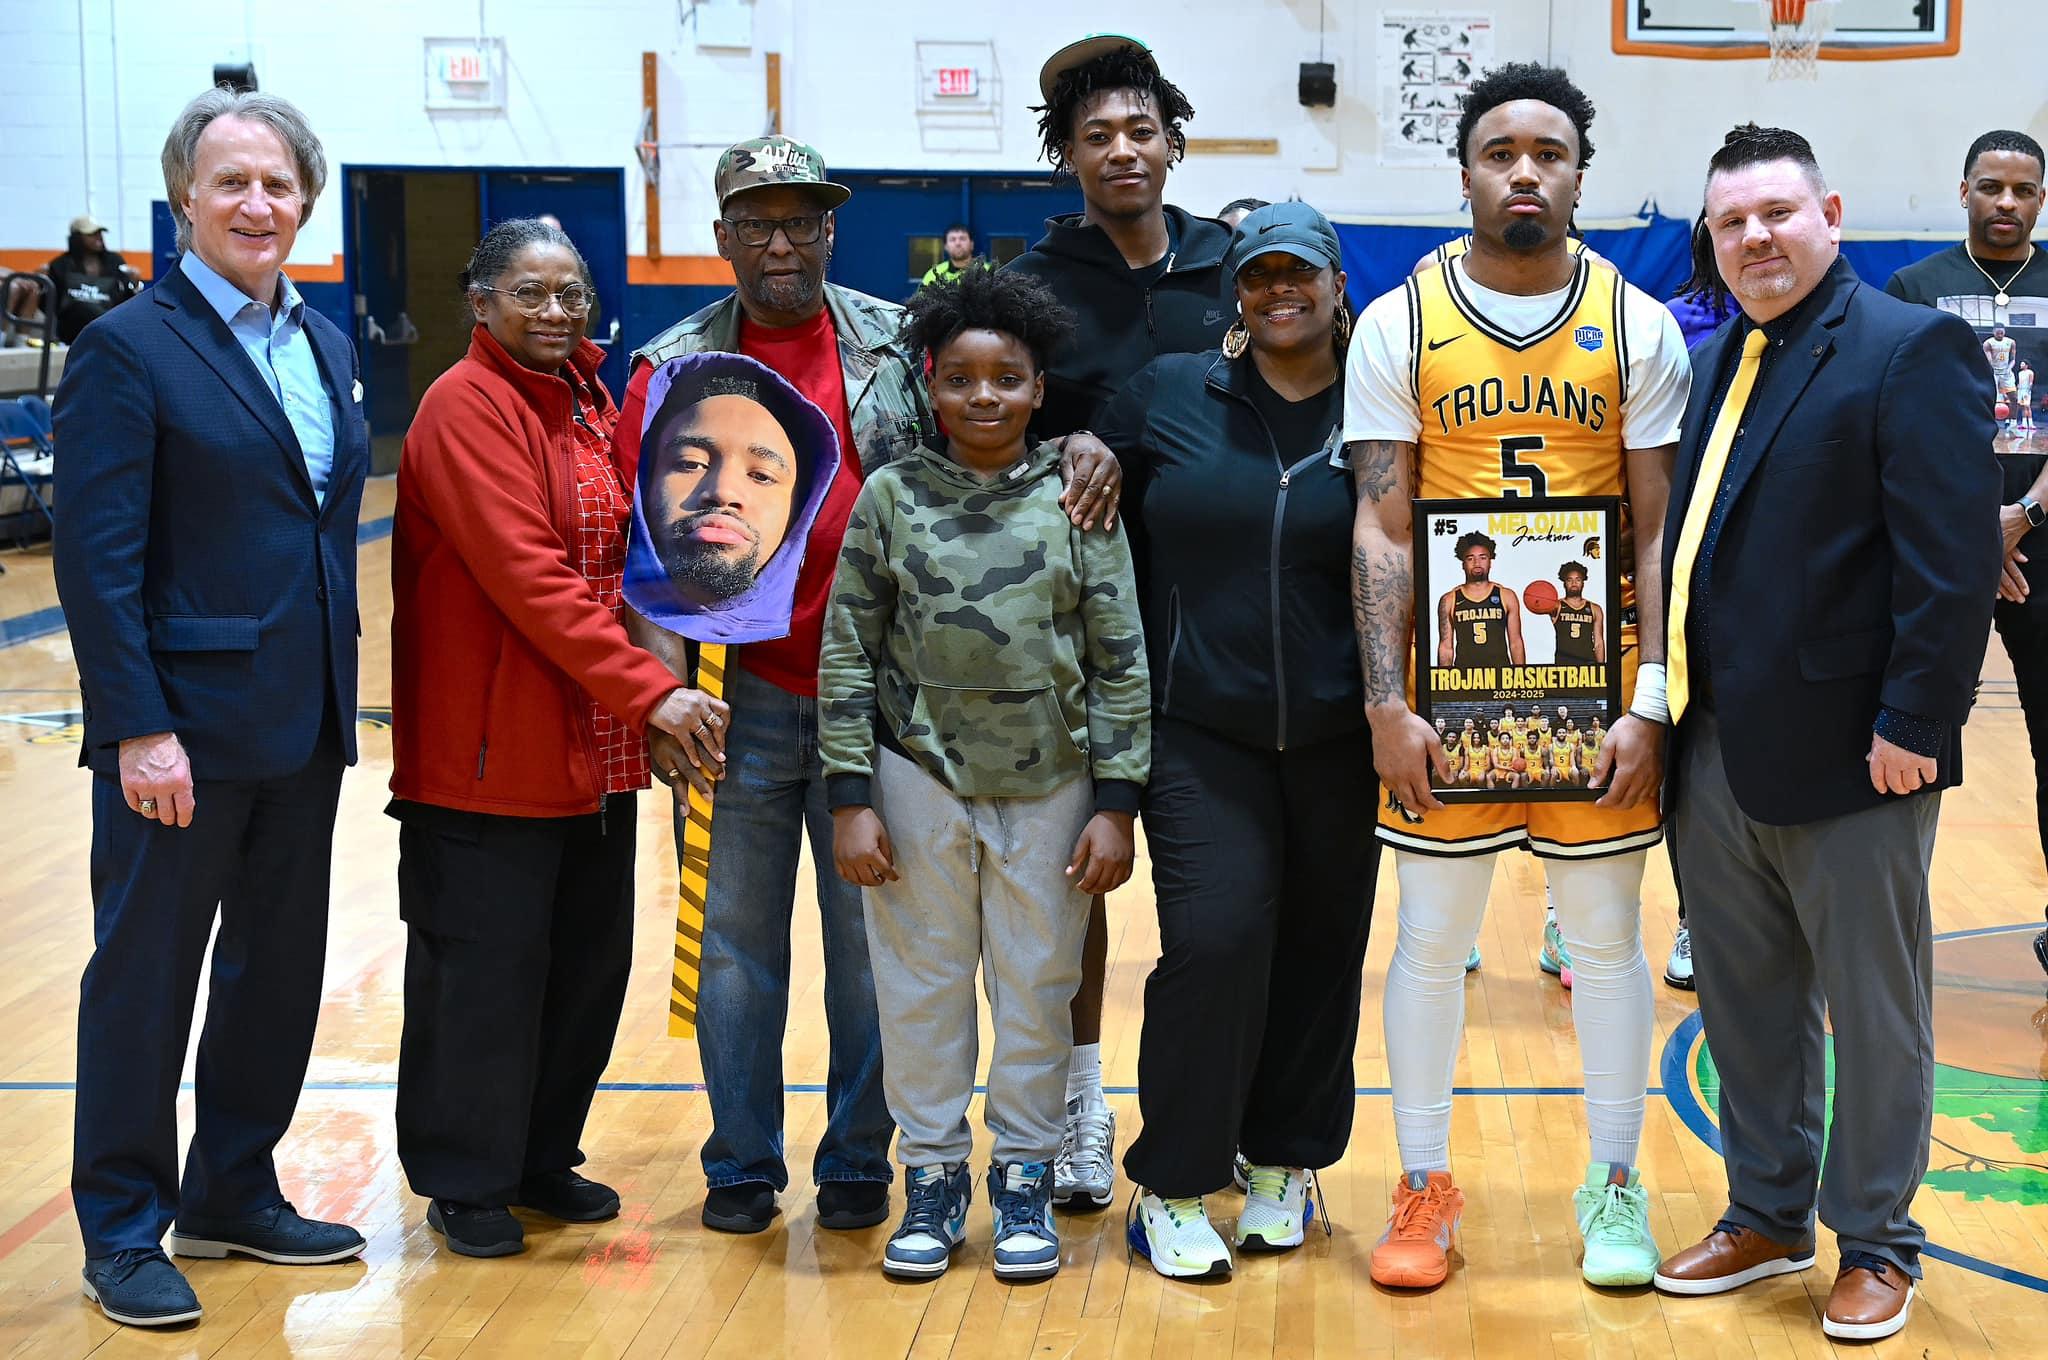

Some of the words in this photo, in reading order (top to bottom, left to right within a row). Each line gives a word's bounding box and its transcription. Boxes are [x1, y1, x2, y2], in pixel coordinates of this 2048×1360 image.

[939, 68, 969, 95] EXIT
[761, 142, 809, 168] Wild
[1205, 310, 1221, 319] NIKE
[1574, 329, 1604, 343] NJCAA
[1432, 374, 1607, 435] TROJANS
[1499, 436, 1548, 498] 5
[1434, 518, 1458, 536] #5
[1511, 525, 1575, 547] Jackson
[1353, 545, 1378, 625] Humble
[1455, 608, 1503, 622] TROJANS
[1560, 613, 1593, 624] TROJANS
[1473, 622, 1488, 645] 5
[1570, 623, 1581, 638] 5
[1430, 667, 1496, 691] TROJAN
[1501, 665, 1608, 689] BASKETBALL
[1493, 690, 1545, 699] 2024-2025
